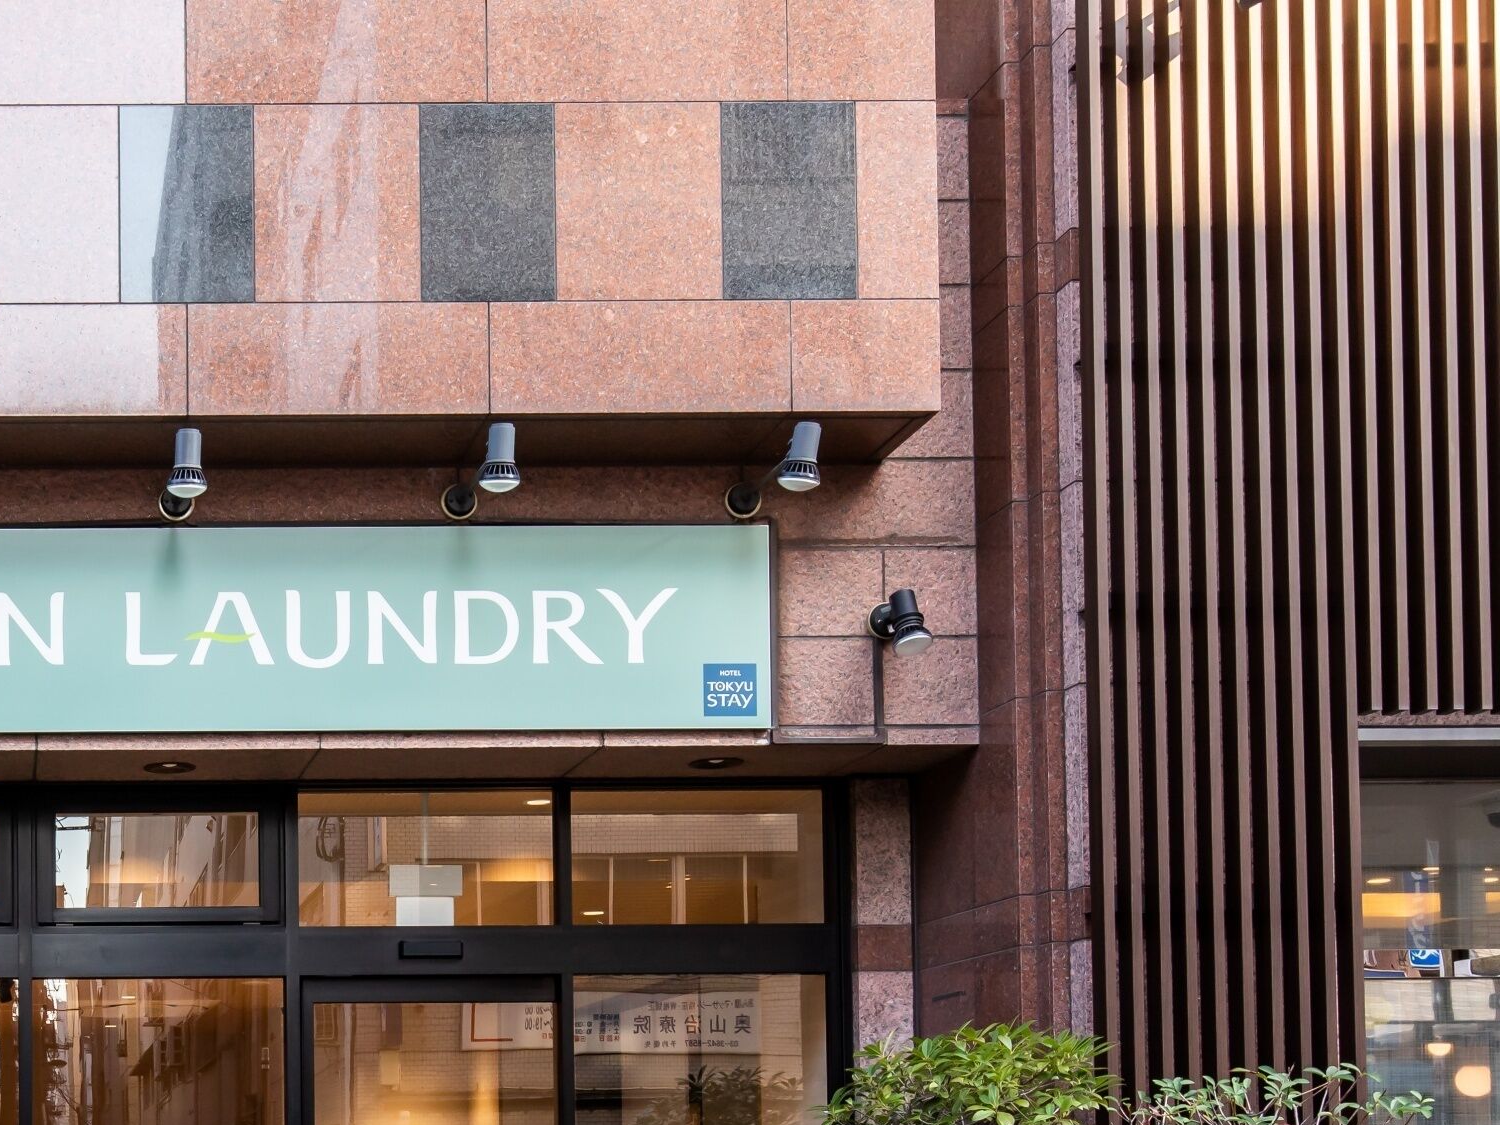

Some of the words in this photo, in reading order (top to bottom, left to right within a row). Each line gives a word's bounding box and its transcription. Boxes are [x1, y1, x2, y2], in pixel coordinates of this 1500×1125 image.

[126, 588, 678, 667] LAUNDRY
[706, 681, 754, 692] TOKYU
[706, 693, 754, 709] STAY
